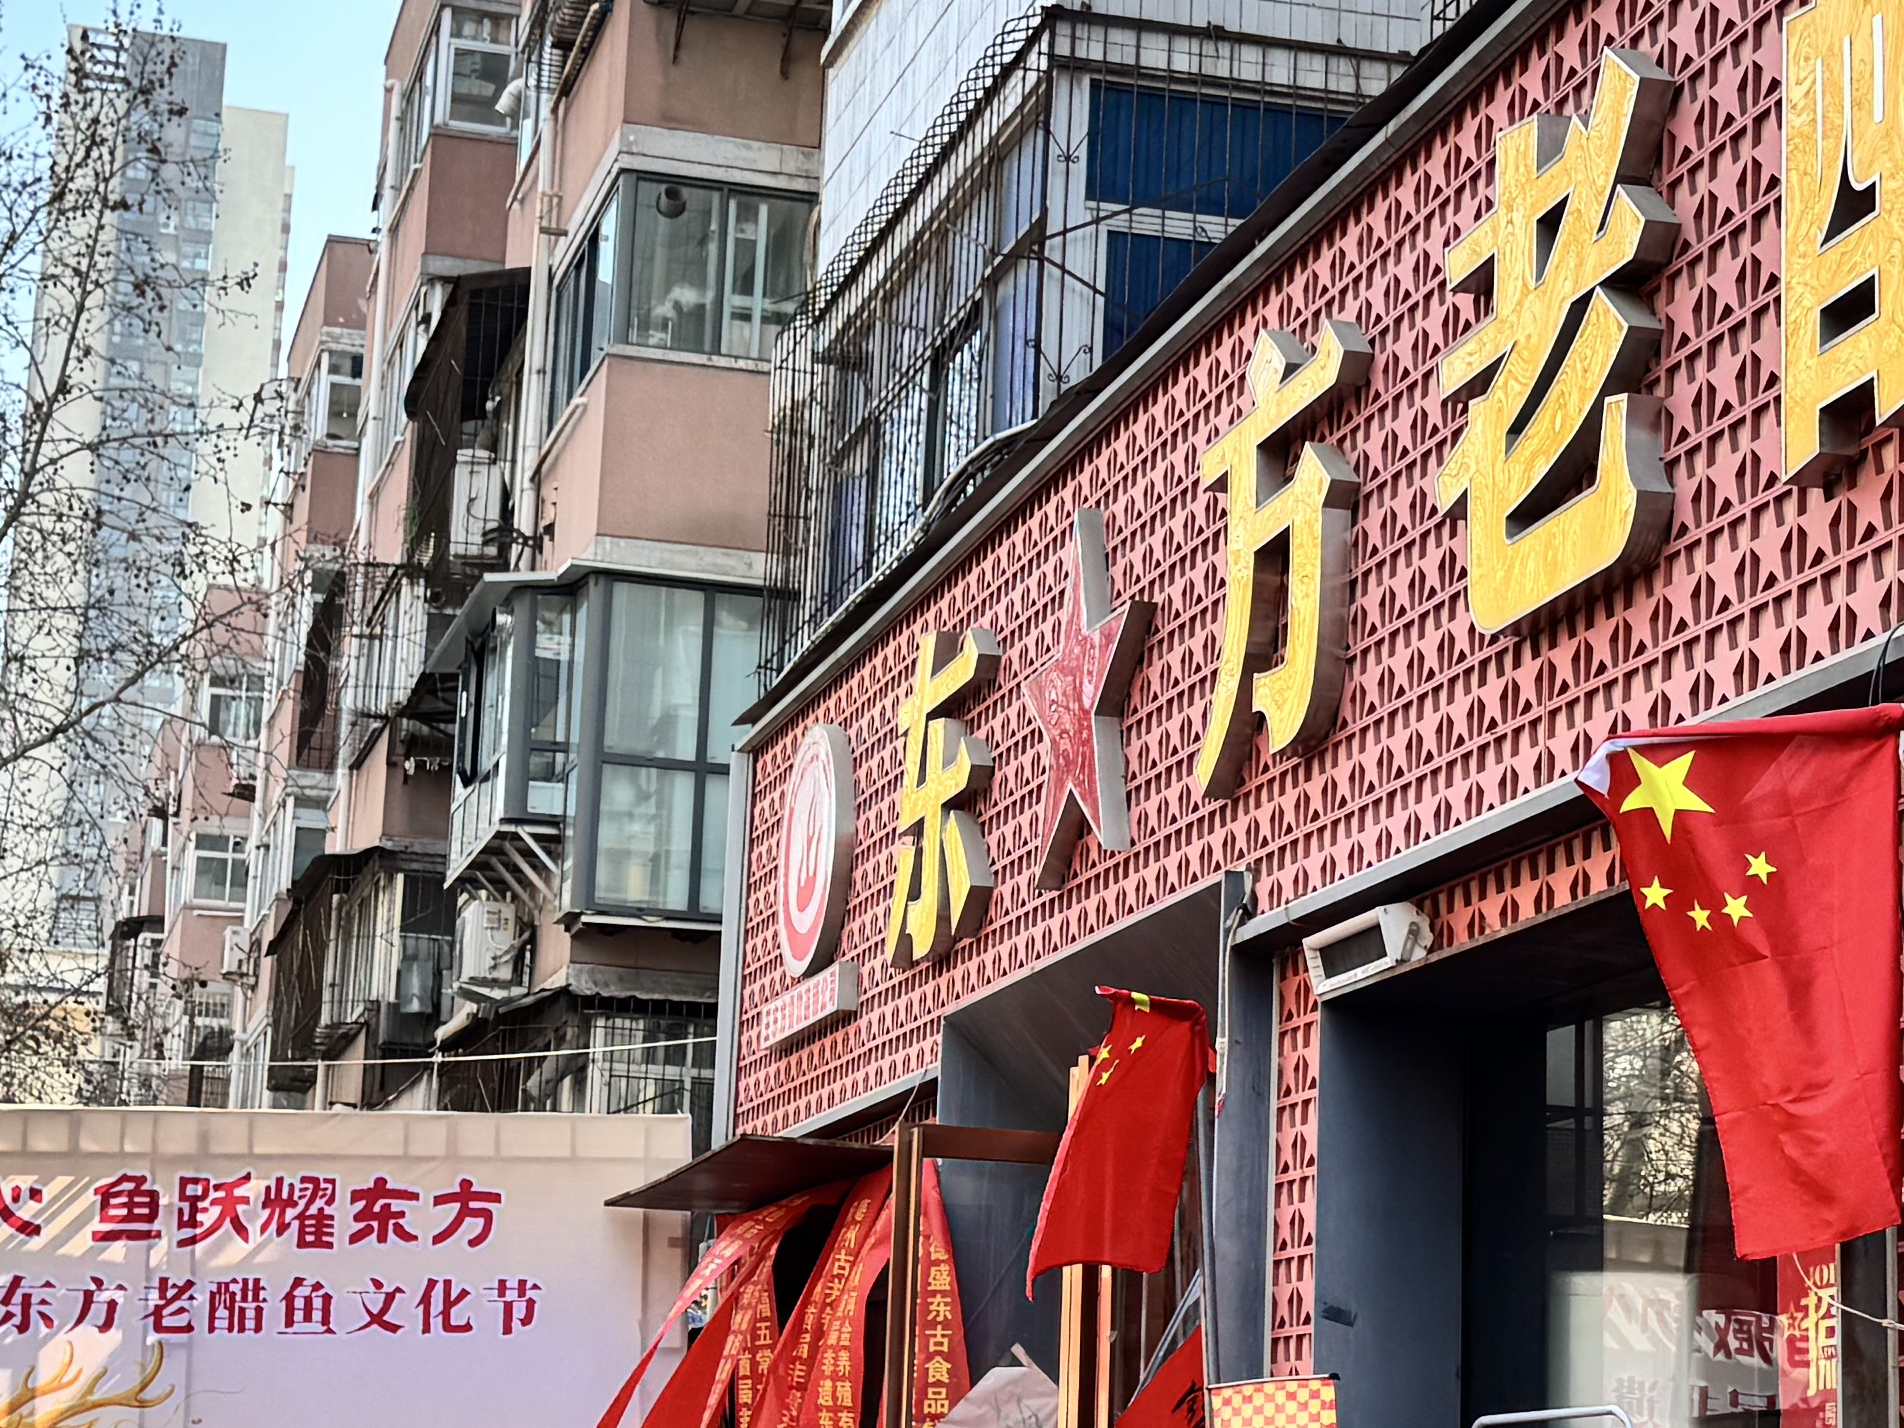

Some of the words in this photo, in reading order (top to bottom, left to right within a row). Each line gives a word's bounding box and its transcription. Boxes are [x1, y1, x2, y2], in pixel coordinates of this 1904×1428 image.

[90, 1170, 503, 1252] 鱼跃耀东方
